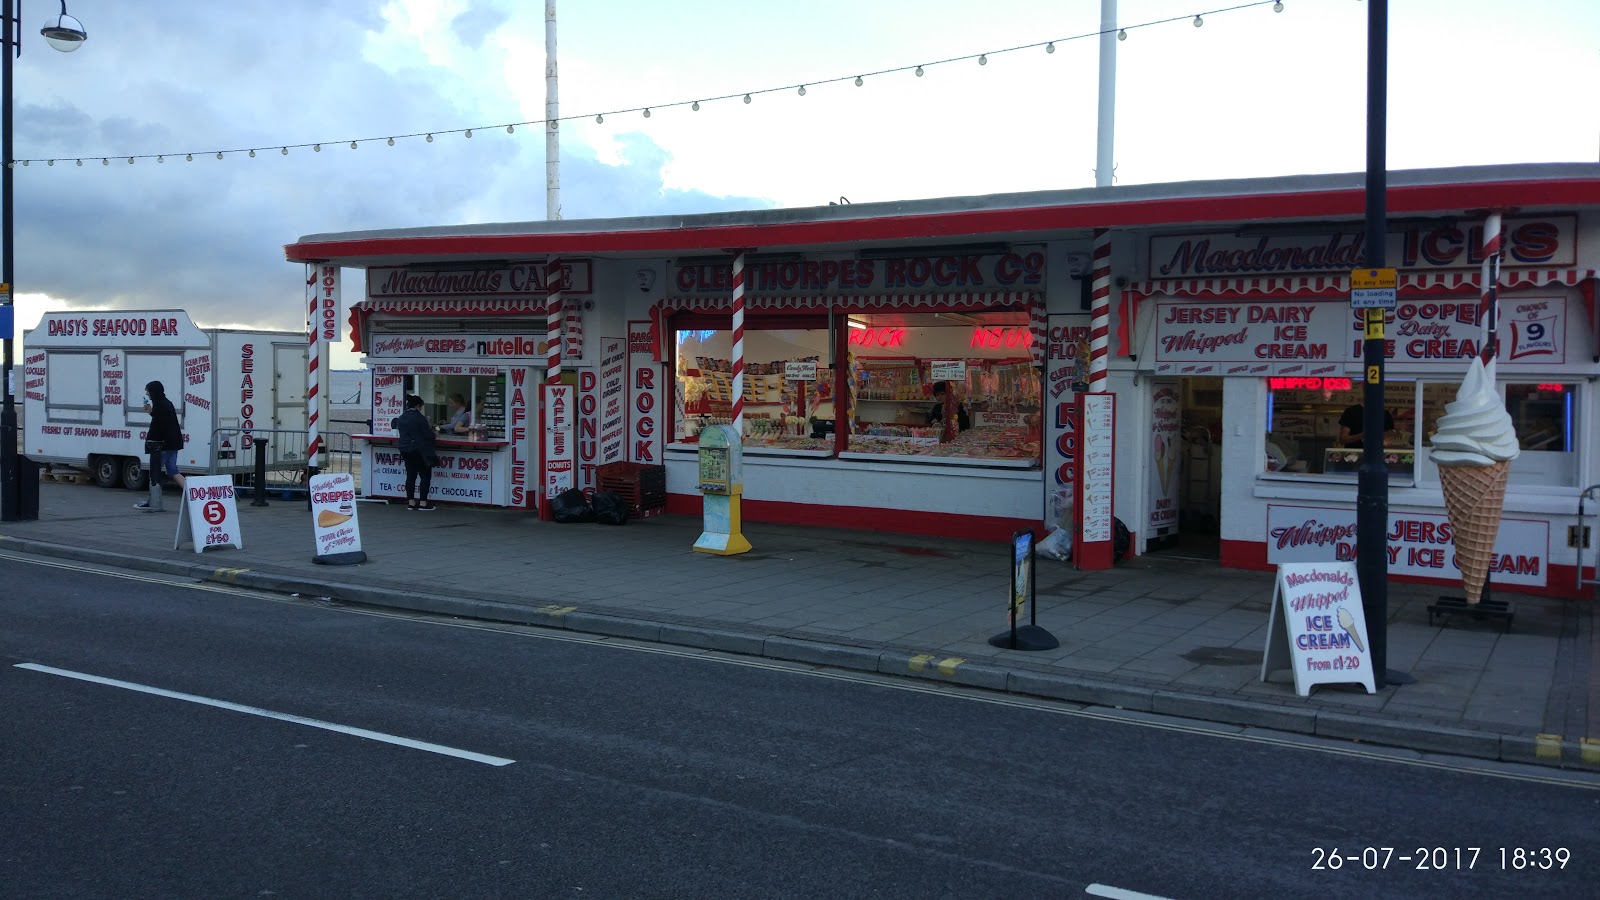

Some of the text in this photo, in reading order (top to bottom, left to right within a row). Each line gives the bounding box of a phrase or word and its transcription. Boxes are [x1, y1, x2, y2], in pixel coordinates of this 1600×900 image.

[381, 264, 574, 293] Macdonald's CAE
[885, 255, 984, 288] ROCK
[1367, 290, 1393, 298] loading
[323, 266, 335, 339] HOT DOGS
[1165, 305, 1316, 324] JERSEY DAIRY
[1528, 311, 1539, 320] OF
[48, 317, 178, 336] DAISY'S SEAFOOD BAR
[1396, 321, 1452, 340] Dairy
[1526, 323, 1545, 341] 9
[848, 328, 905, 347] ROCK
[1161, 326, 1308, 354] Whipped ICE
[425, 339, 467, 353] CREPES
[477, 337, 534, 355] nutella
[608, 343, 618, 353] TEA
[1254, 343, 1328, 360] CREAM
[1354, 340, 1395, 358] IE
[1518, 342, 1552, 350] FLAVOURS
[26, 367, 46, 376] COCKLES
[103, 371, 123, 379] DRESSED
[185, 363, 211, 377] LOBSTER
[1370, 370, 1378, 380] 2
[26, 378, 45, 389] WHELKS
[189, 374, 205, 385] TAILS
[375, 375, 402, 387] DONUTS
[1270, 377, 1321, 389] WHIPPED
[26, 391, 45, 401] MUSSELS
[104, 395, 122, 405] CRABS
[185, 393, 211, 410] CRABSTIX
[241, 344, 254, 449] SEAFOOD
[375, 392, 382, 406] 5
[635, 367, 655, 462] ROCK
[42, 426, 62, 435] FRESHLY
[63, 427, 73, 436] CUT
[74, 428, 99, 437] SEAFOOD
[101, 430, 131, 440] BAGUETTES
[511, 369, 525, 504] WAFFLES
[580, 372, 596, 509] DONUTS
[603, 440, 621, 454] BACON
[458, 457, 489, 471] DOGS
[549, 461, 571, 469] DONUTS
[451, 472, 470, 480] MEDIUM
[550, 476, 556, 484] 5
[190, 485, 234, 501] DO-NUTS
[313, 490, 354, 503] CREPES
[380, 483, 392, 491] TEA
[441, 487, 483, 498] CHOCOLATE
[207, 503, 221, 518] 5
[1408, 548, 1445, 568] ICE
[1285, 569, 1354, 588] Macdonalds
[1290, 586, 1350, 612] Whipped
[1305, 615, 1333, 632] ICE
[1296, 633, 1350, 651] CREAM
[1307, 657, 1332, 671] From
